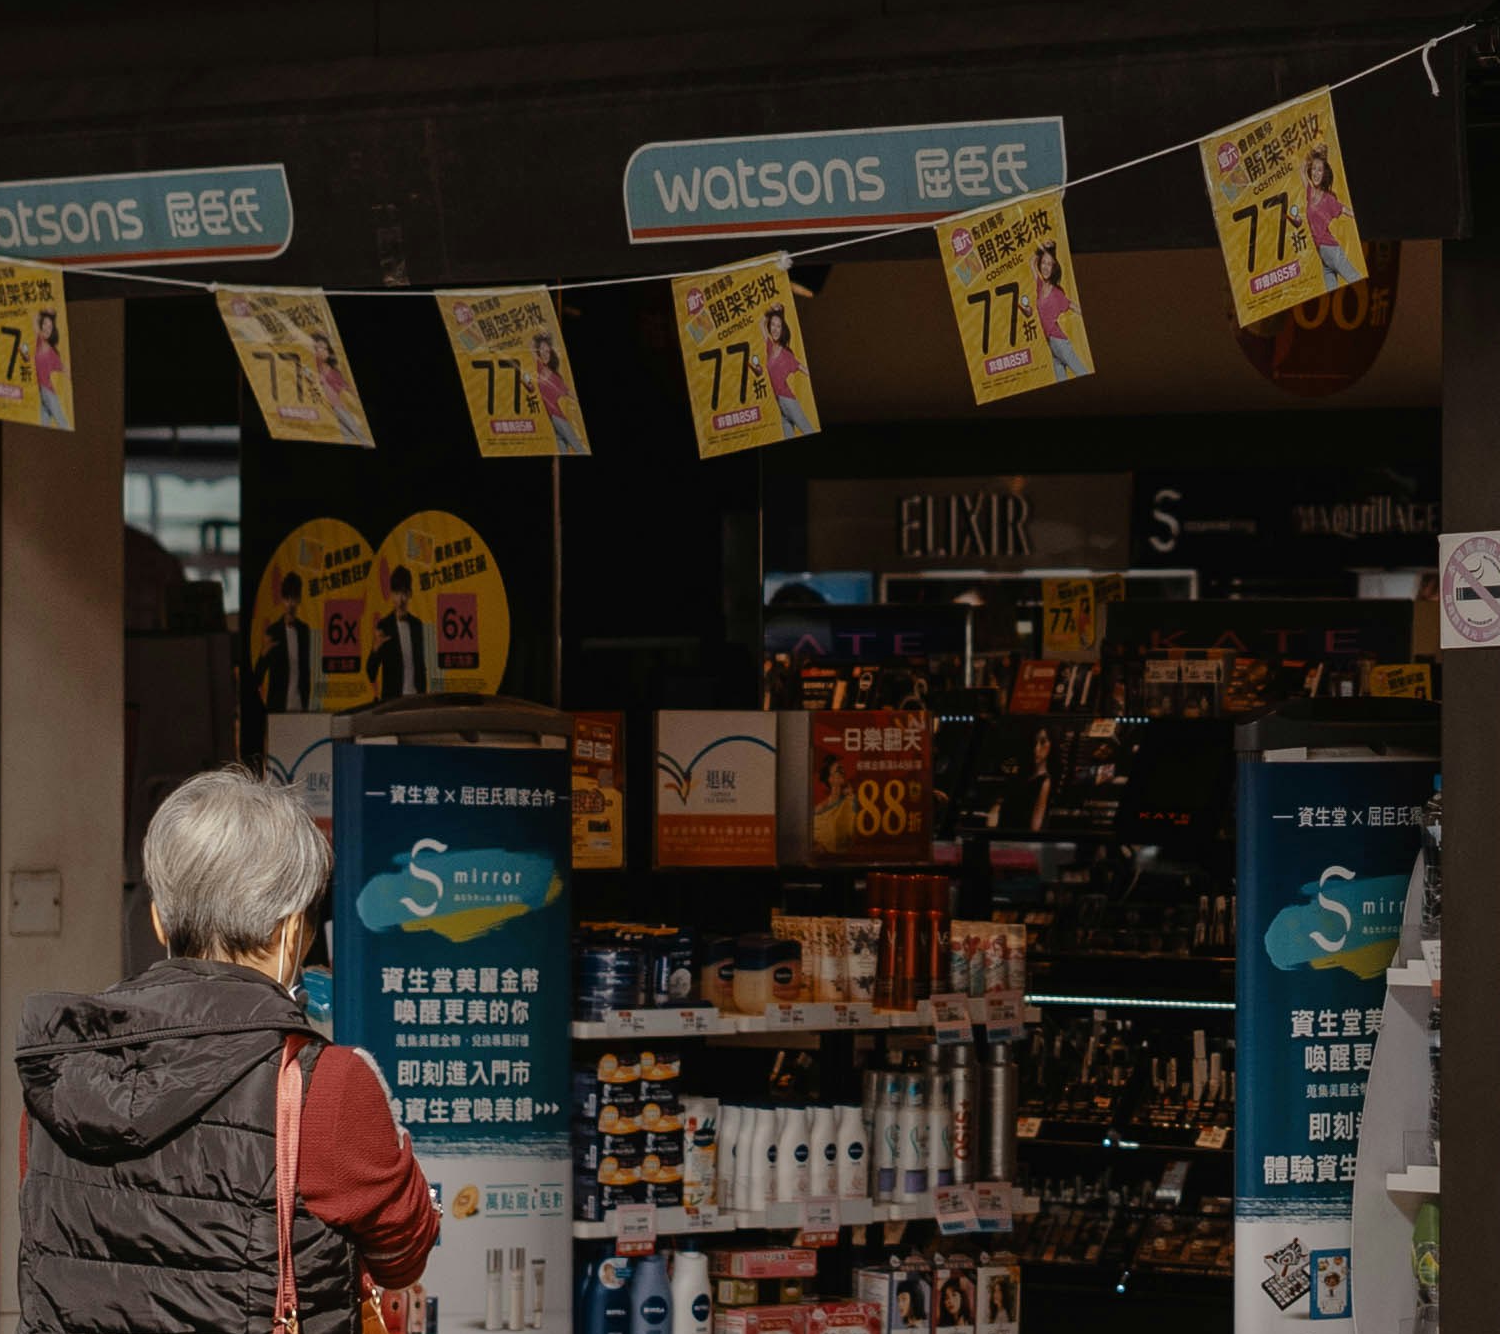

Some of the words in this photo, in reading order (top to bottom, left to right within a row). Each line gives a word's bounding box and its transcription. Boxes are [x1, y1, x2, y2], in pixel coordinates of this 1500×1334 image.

[1243, 113, 1324, 183] 開架彩妝
[652, 154, 887, 215] watsons
[914, 143, 1033, 201] 屈臣氏
[1252, 161, 1293, 195] cosmetic
[166, 187, 264, 241] 屈臣氏
[977, 209, 1053, 270] 開架彩妝
[986, 255, 1024, 282] cosmetic
[708, 273, 780, 328] 開架彩妝
[717, 315, 754, 340] cosmetic
[1022, 320, 1038, 343] 折
[252, 352, 304, 404] 77
[472, 359, 520, 416] 77
[753, 378, 768, 400] 折
[901, 492, 1030, 557] ELIXIR
[328, 612, 357, 645] 6x
[442, 607, 474, 641] 6x
[1151, 628, 1360, 655] KATE
[822, 727, 923, 753] 一日樂翻天
[389, 784, 439, 806] 資生堂
[460, 786, 556, 809] 屈臣氏獨家合作
[856, 779, 906, 836] 88
[1297, 806, 1348, 828] 資生堂
[452, 868, 523, 885] mirror
[381, 967, 540, 994] 資生堂美麗金幣
[393, 998, 530, 1025] 喚醒更美的你
[397, 1059, 531, 1087] 即刻進入門市
